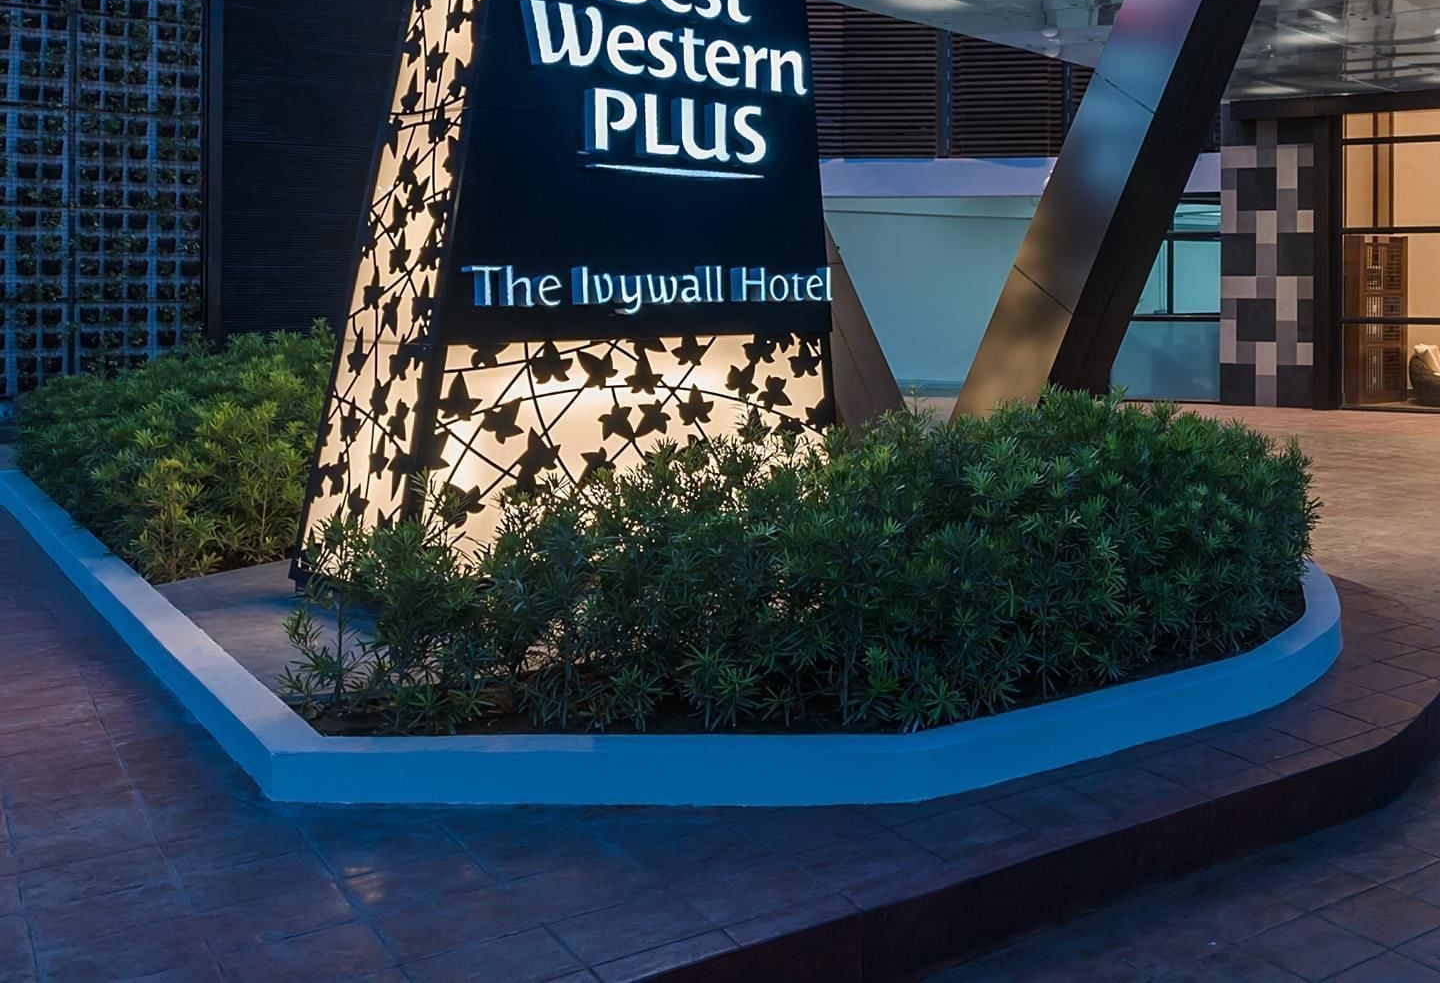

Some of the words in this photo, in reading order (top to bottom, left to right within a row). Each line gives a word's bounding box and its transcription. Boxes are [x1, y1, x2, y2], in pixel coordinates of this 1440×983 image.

[592, 87, 768, 164] PLUS
[468, 264, 563, 308] The
[577, 264, 725, 316] Ivywall
[739, 265, 835, 303] Hotel
